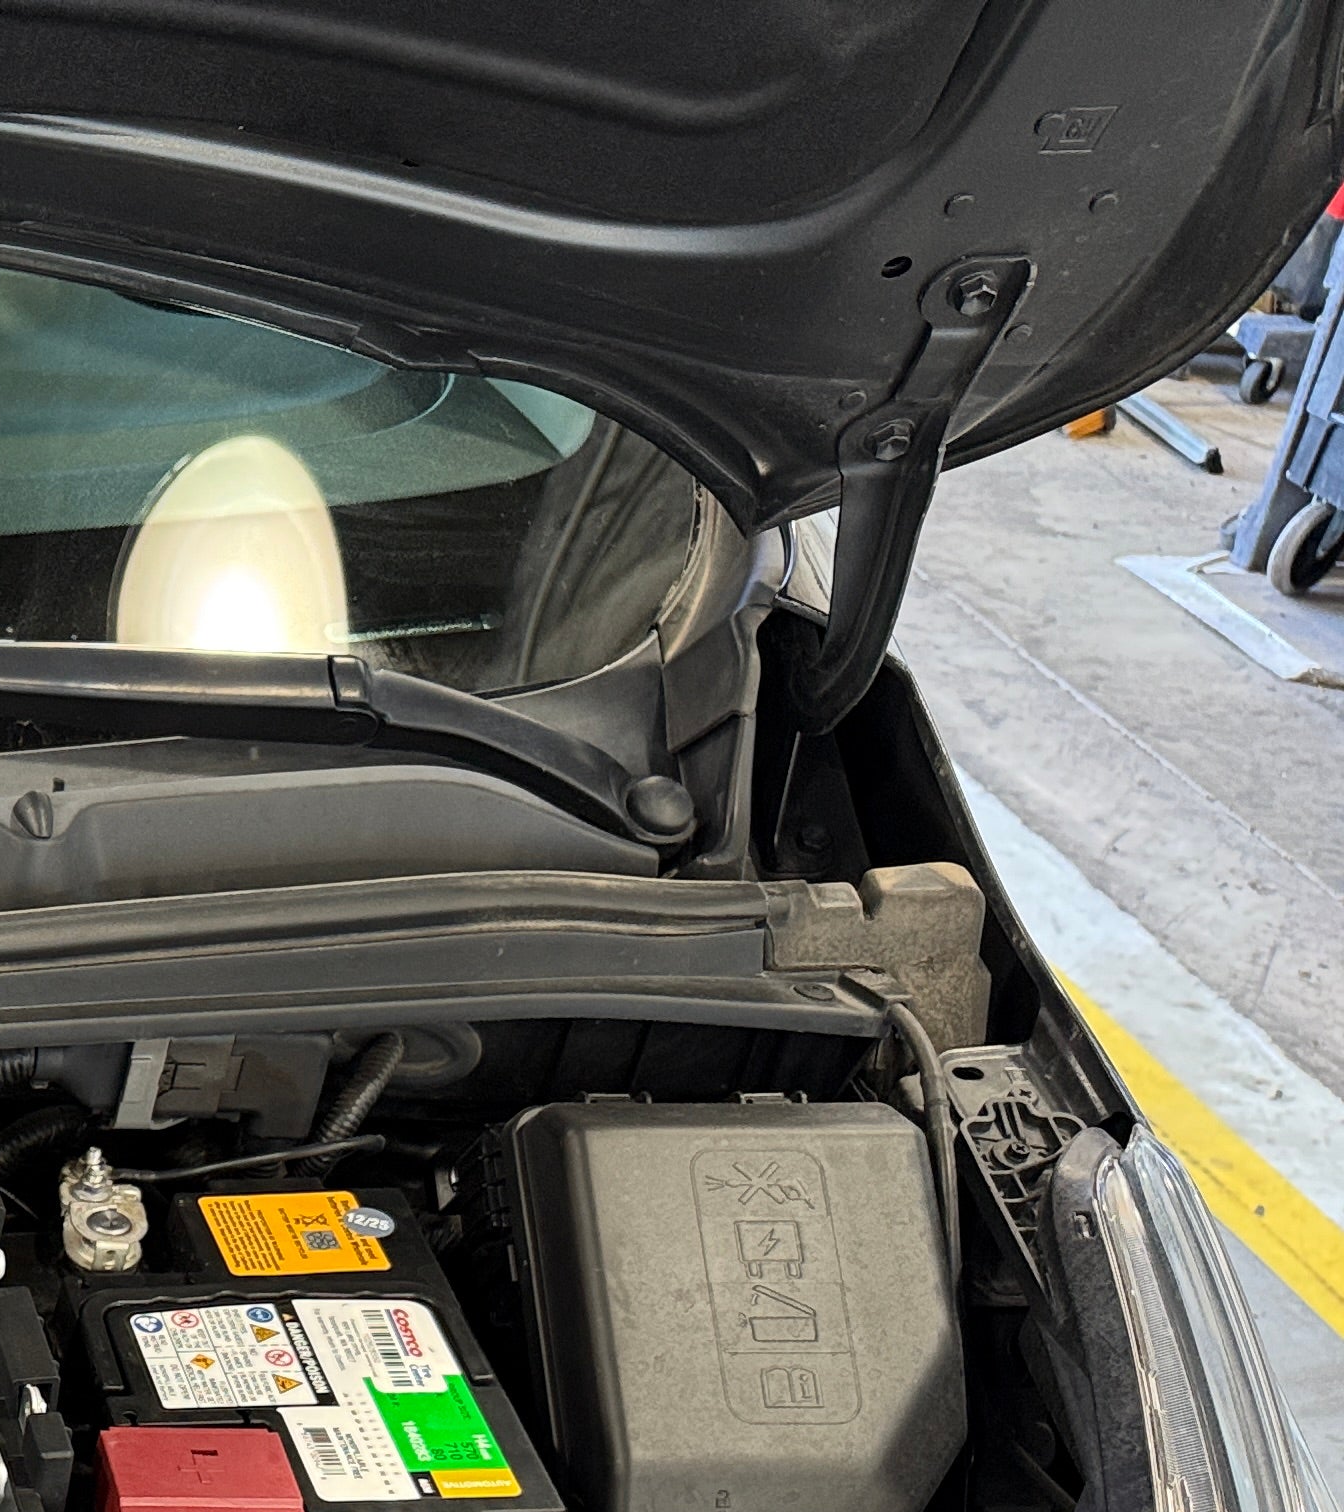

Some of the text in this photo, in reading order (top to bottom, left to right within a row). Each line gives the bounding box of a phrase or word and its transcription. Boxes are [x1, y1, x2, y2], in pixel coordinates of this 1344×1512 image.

[346, 1212, 390, 1231] 12/25
[286, 1322, 330, 1394] DANGER/POISON
[445, 1442, 463, 1461] 710
[461, 1441, 480, 1461] 570
